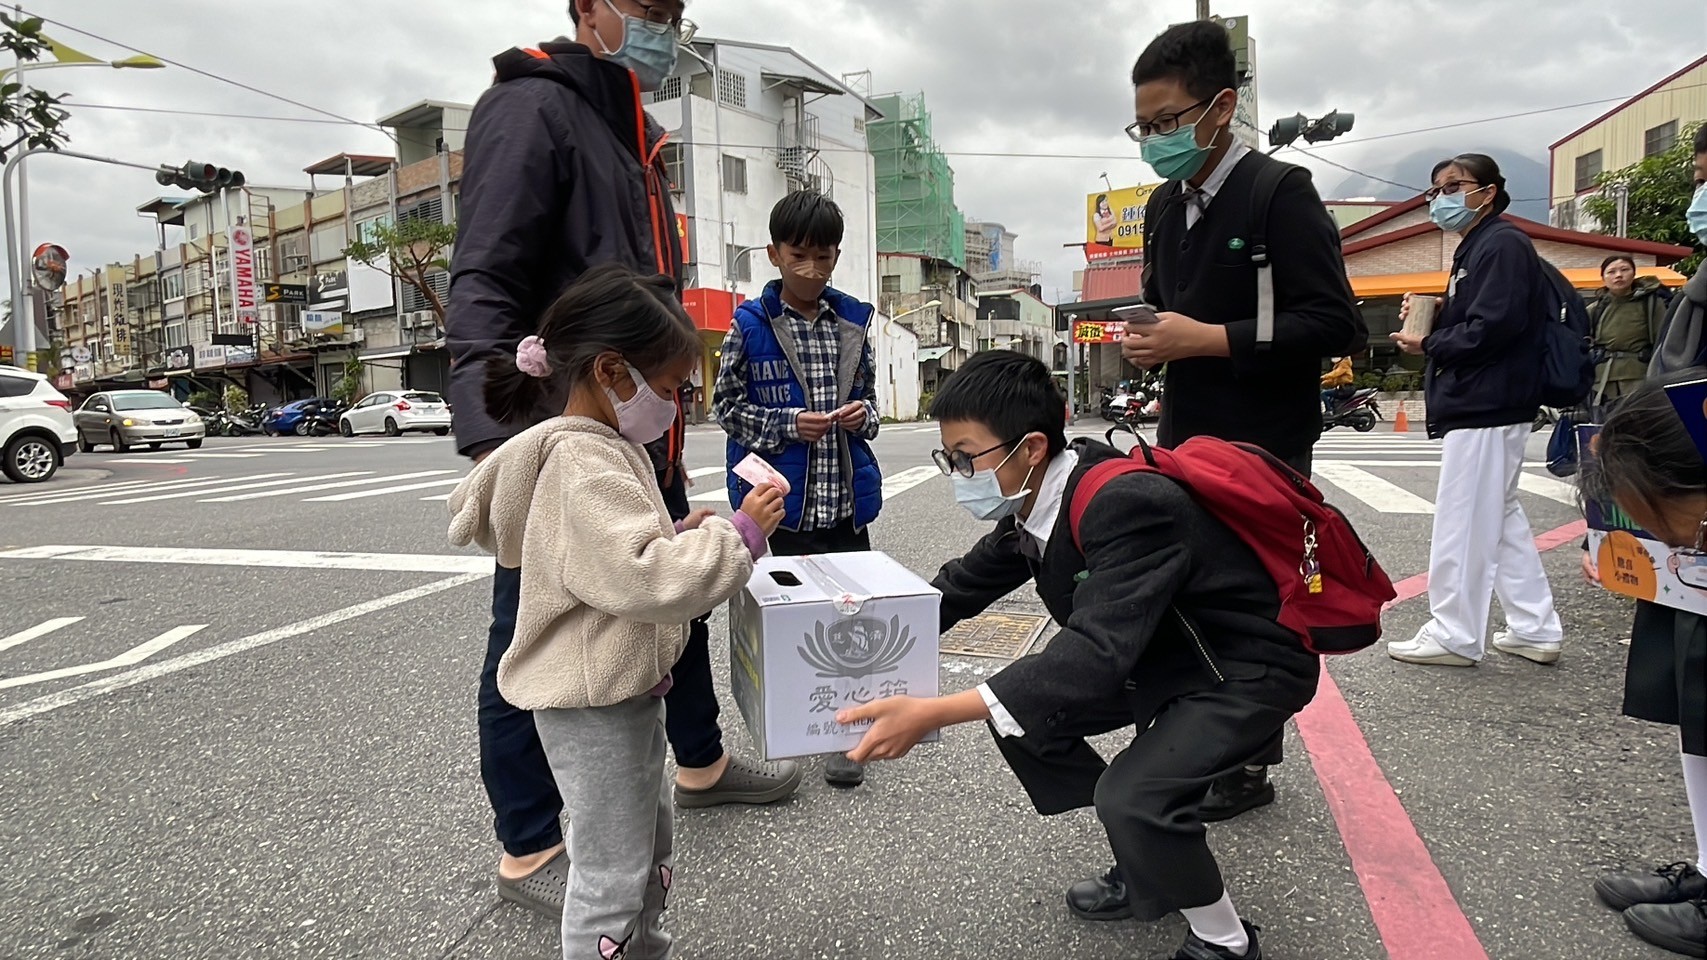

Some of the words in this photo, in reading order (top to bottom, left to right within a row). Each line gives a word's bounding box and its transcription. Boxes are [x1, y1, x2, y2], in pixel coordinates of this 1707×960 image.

[1118, 223, 1145, 237] 0915
[235, 248, 255, 308] YAMAHA
[283, 288, 305, 296] PARK
[750, 359, 790, 382] HAVE
[755, 383, 792, 404] NICE
[809, 679, 908, 713] 愛心箱
